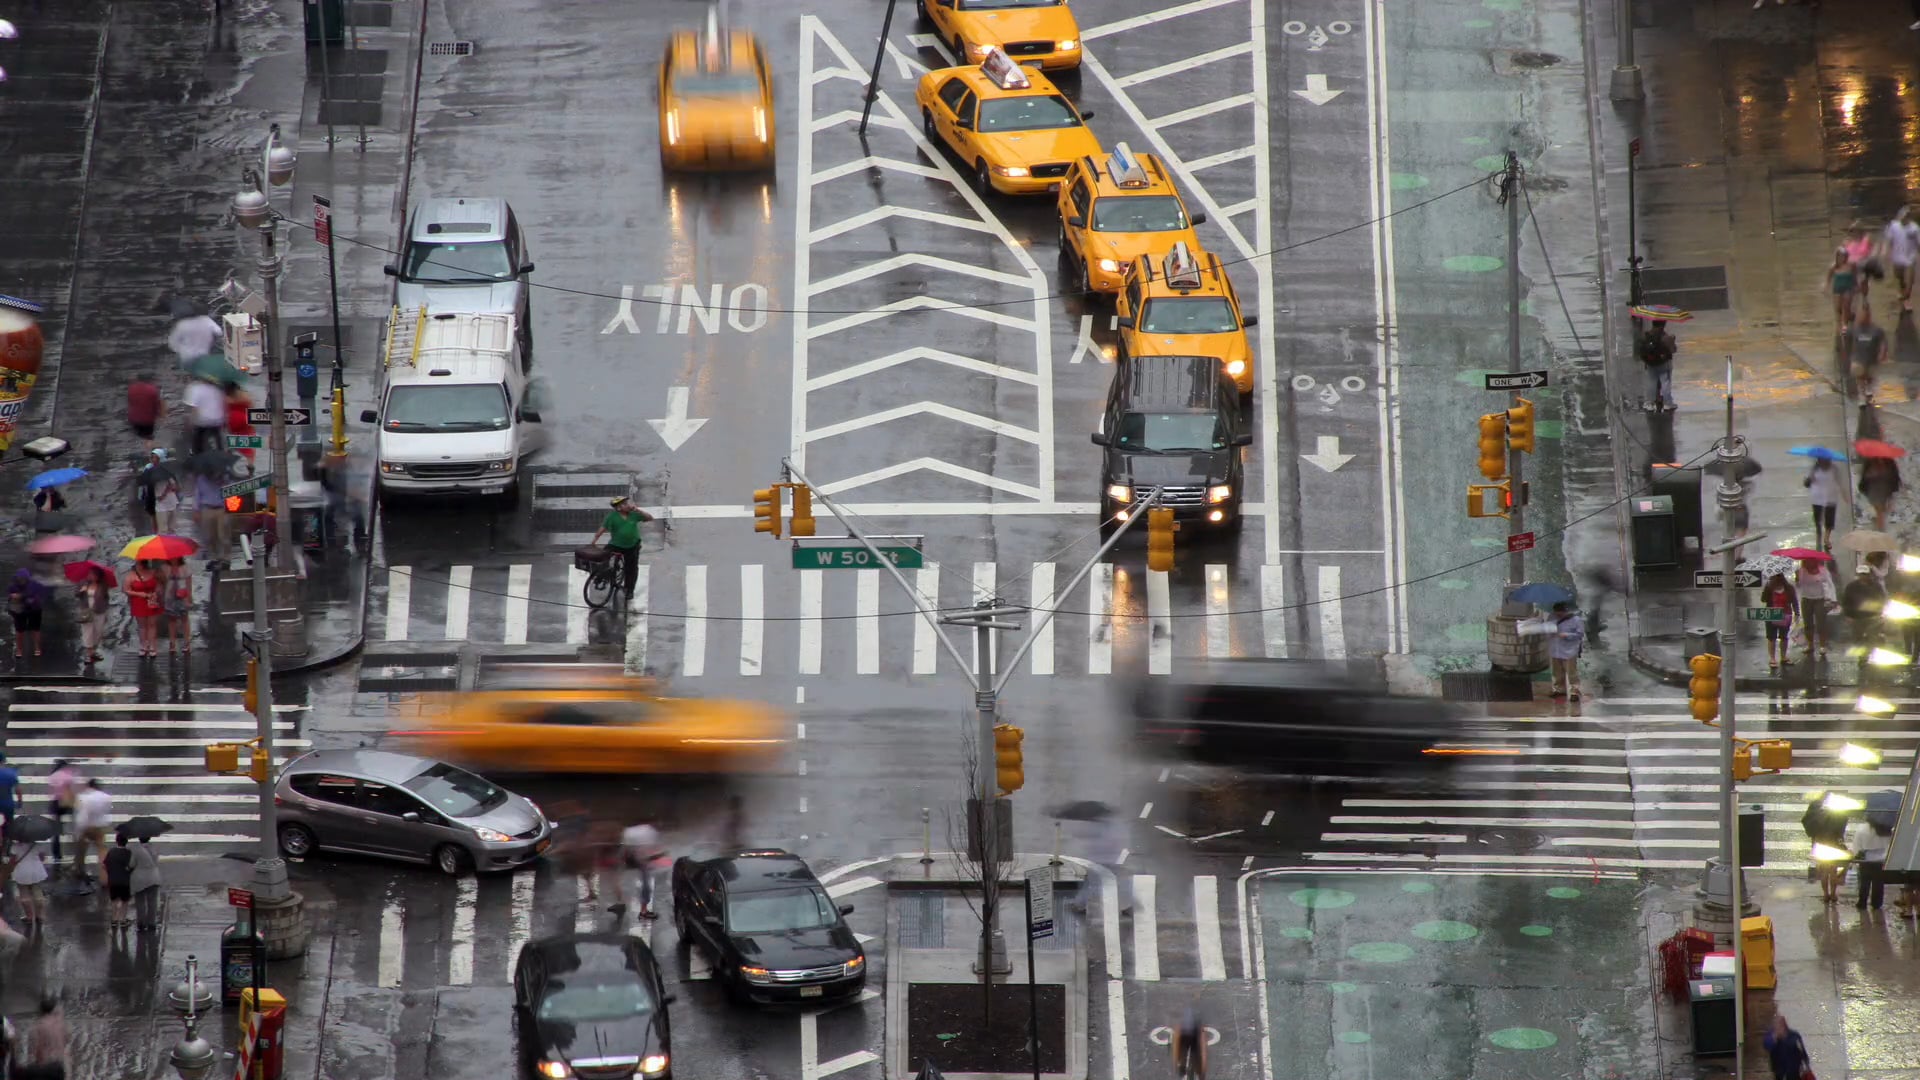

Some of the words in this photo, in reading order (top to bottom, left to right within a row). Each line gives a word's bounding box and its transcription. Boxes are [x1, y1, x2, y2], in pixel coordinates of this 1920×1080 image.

[600, 283, 768, 335] ONLY
[1494, 378, 1513, 386] ONE
[1520, 376, 1538, 385] WAY
[229, 437, 237, 447] W
[817, 551, 833, 565] W
[841, 551, 869, 565] 50
[876, 551, 899, 565] St
[1704, 576, 1722, 584] ONE
[1749, 609, 1757, 620] W
[1760, 609, 1771, 620] 50
